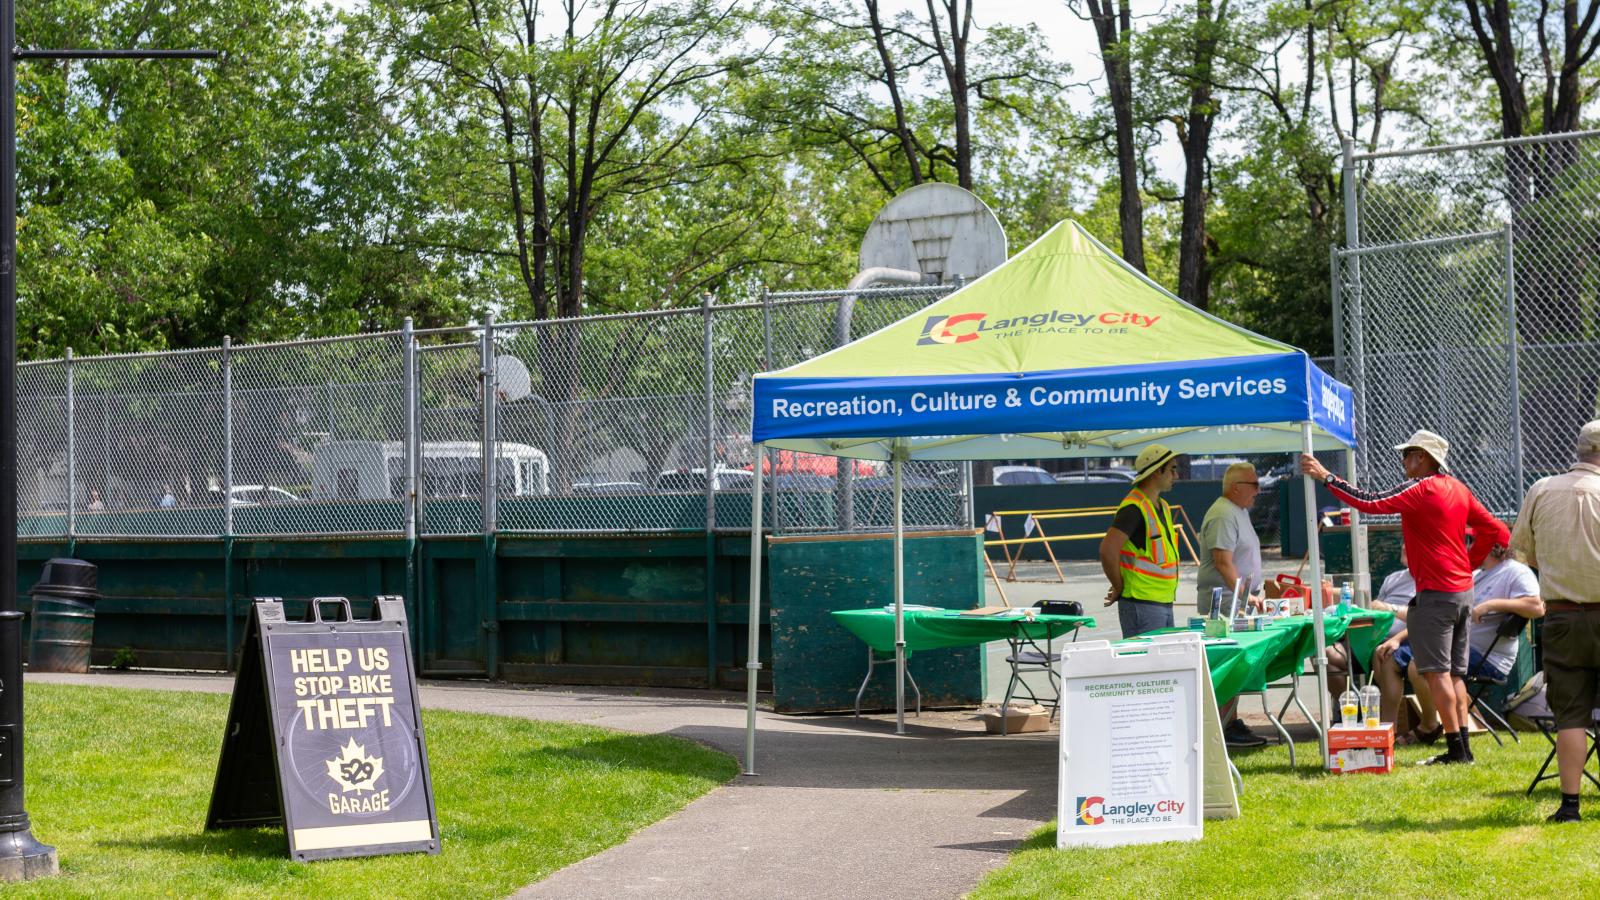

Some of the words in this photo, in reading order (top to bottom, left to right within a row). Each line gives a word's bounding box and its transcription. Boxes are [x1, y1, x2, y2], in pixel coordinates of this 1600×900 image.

[977, 310, 1096, 332] Langley
[1098, 312, 1161, 328] City
[993, 329, 1023, 339] THE
[1026, 327, 1078, 335] PLACE
[1083, 327, 1104, 335] TO
[772, 395, 903, 418] Recreation,
[910, 391, 998, 413] Culture
[1004, 387, 1022, 408] &
[1029, 381, 1171, 406] Community
[1178, 376, 1287, 400] Services
[290, 648, 353, 673] HELP
[358, 647, 390, 671] US
[295, 676, 344, 697] STOP
[349, 674, 393, 694] BIKE
[1084, 682, 1134, 691] RECREATION,
[1135, 679, 1171, 688] CULTURE
[1089, 689, 1135, 698] COMMUNITY
[1137, 686, 1174, 695] SERVICES
[297, 696, 394, 731] THEFT
[340, 758, 374, 785] 529
[328, 788, 391, 814] GARAGE
[1102, 801, 1155, 817] Langley
[1157, 800, 1185, 814] City
[1126, 816, 1150, 824] PLACE
